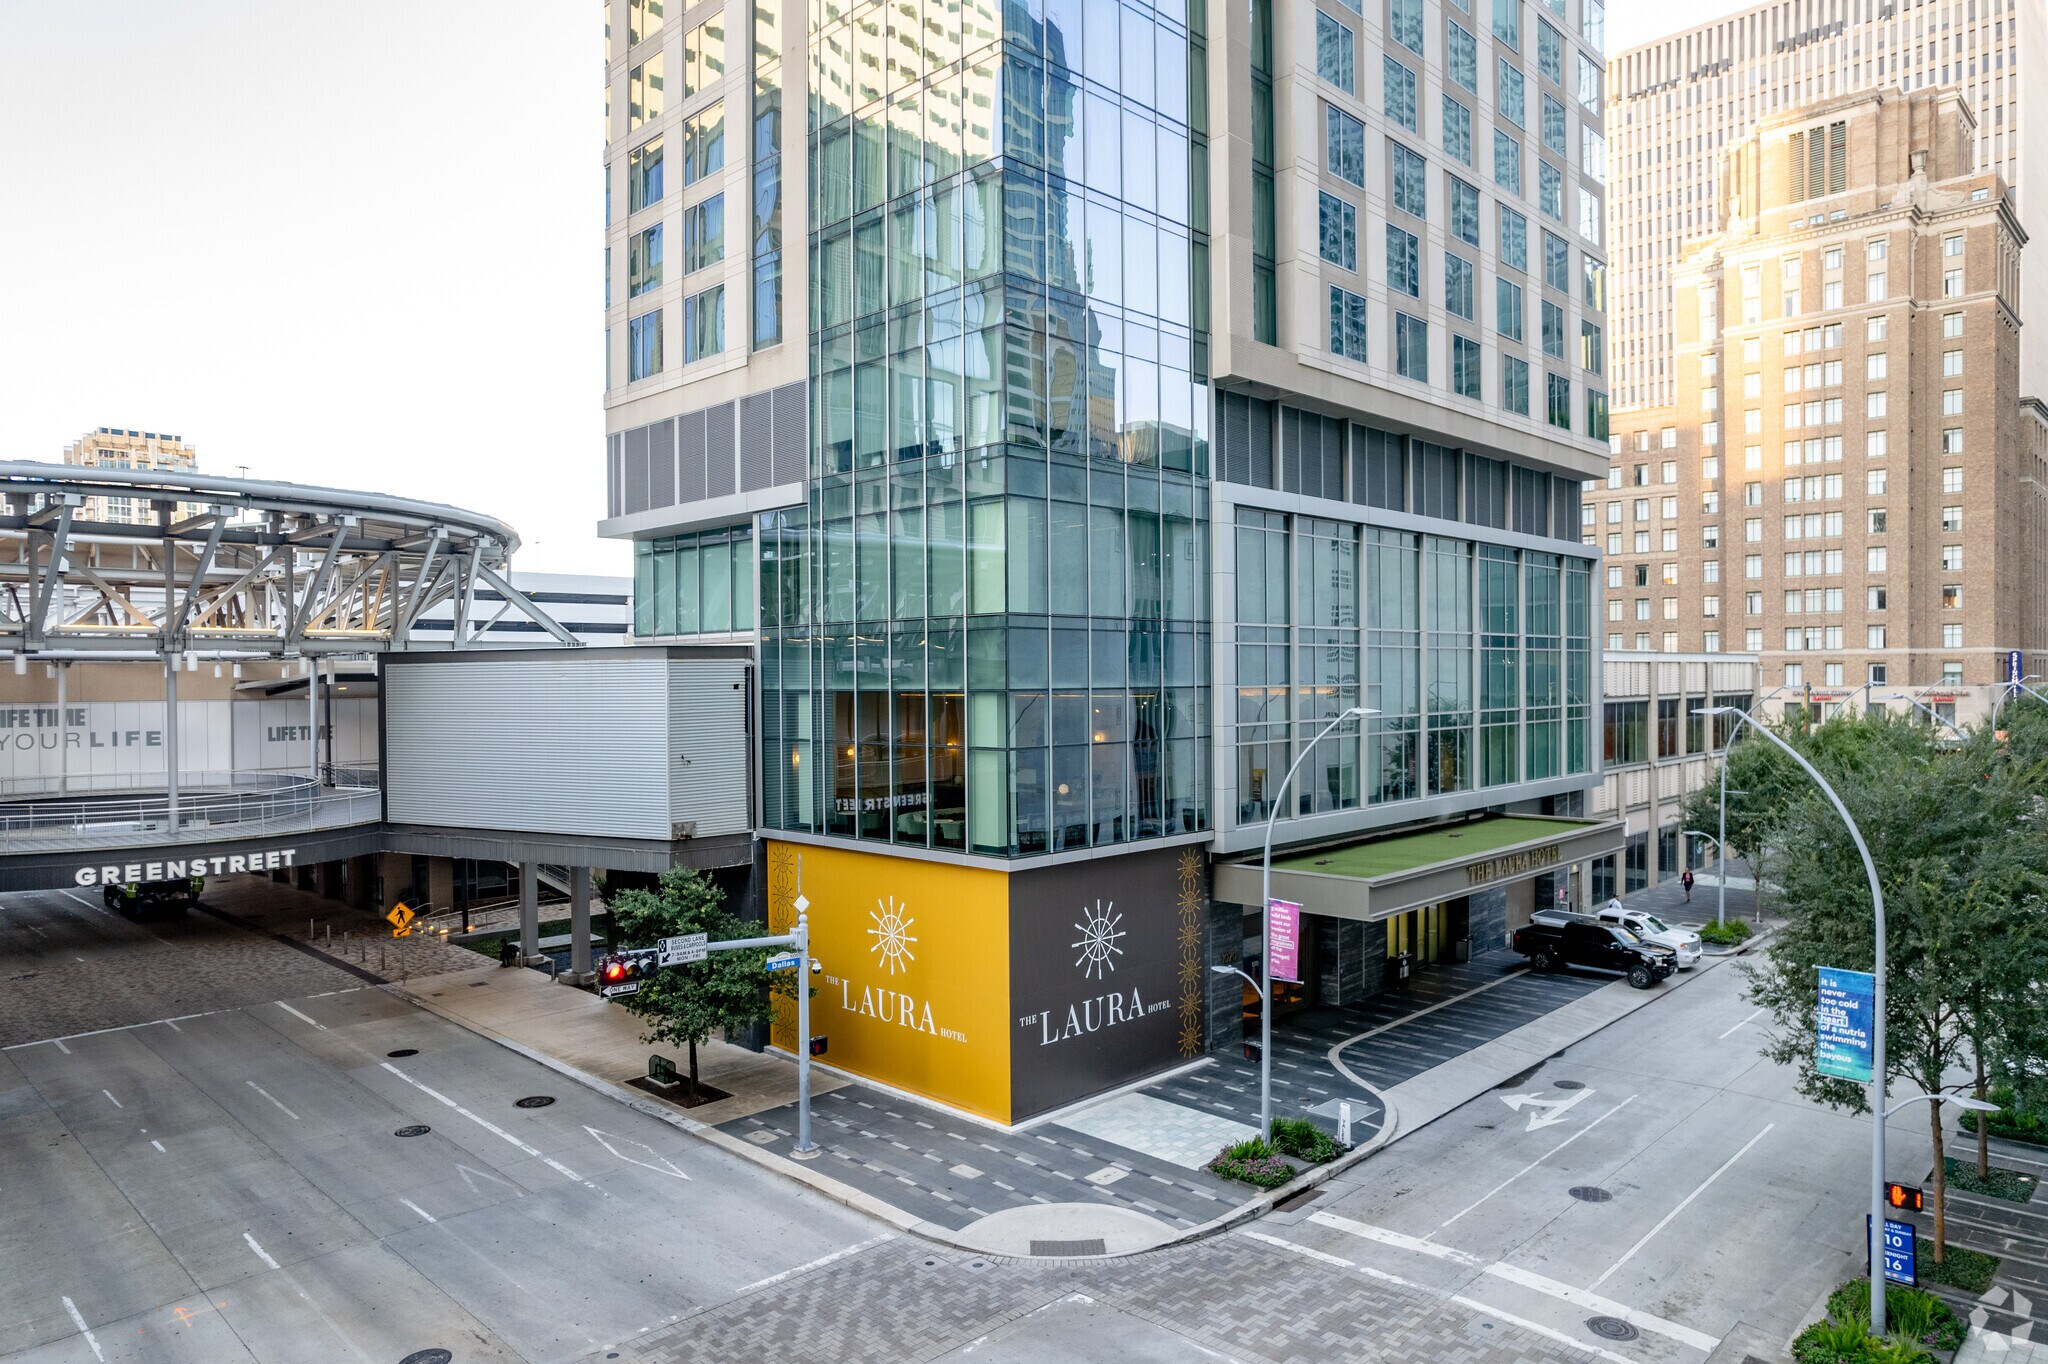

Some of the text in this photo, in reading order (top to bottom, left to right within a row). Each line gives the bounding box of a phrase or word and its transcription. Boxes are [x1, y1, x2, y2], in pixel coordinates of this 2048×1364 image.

[0, 708, 85, 728] IFE TIME
[0, 731, 162, 750] YOUR LIFE
[268, 726, 297, 742] LIFE
[75, 849, 296, 887] GREENSTREET
[1469, 847, 1563, 884] THE LAURA HOTEL
[671, 935, 705, 946] SECOND LANE
[686, 940, 706, 950] CARPOOLS
[771, 960, 795, 969] Dallas
[1821, 978, 1837, 987] it is
[610, 986, 620, 994] ONE
[1821, 988, 1846, 998] never
[825, 974, 967, 1043] THE LAURA HOTEL
[1821, 996, 1858, 1009] too cold
[1019, 987, 1171, 1046] THE LAURA HOTEL
[1821, 1005, 1846, 1016] in the
[1820, 1014, 1845, 1025] heart
[1820, 1024, 1830, 1032] of
[1839, 1028, 1865, 1038] nutria
[1820, 1034, 1867, 1048] swimming
[1820, 1041, 1836, 1050] the
[1820, 1050, 1852, 1063] bayous
[1890, 1222, 1902, 1230] DAY
[1885, 1234, 1902, 1248] 10
[1885, 1250, 1909, 1260] ERNIGHT
[1885, 1257, 1902, 1271] 16
